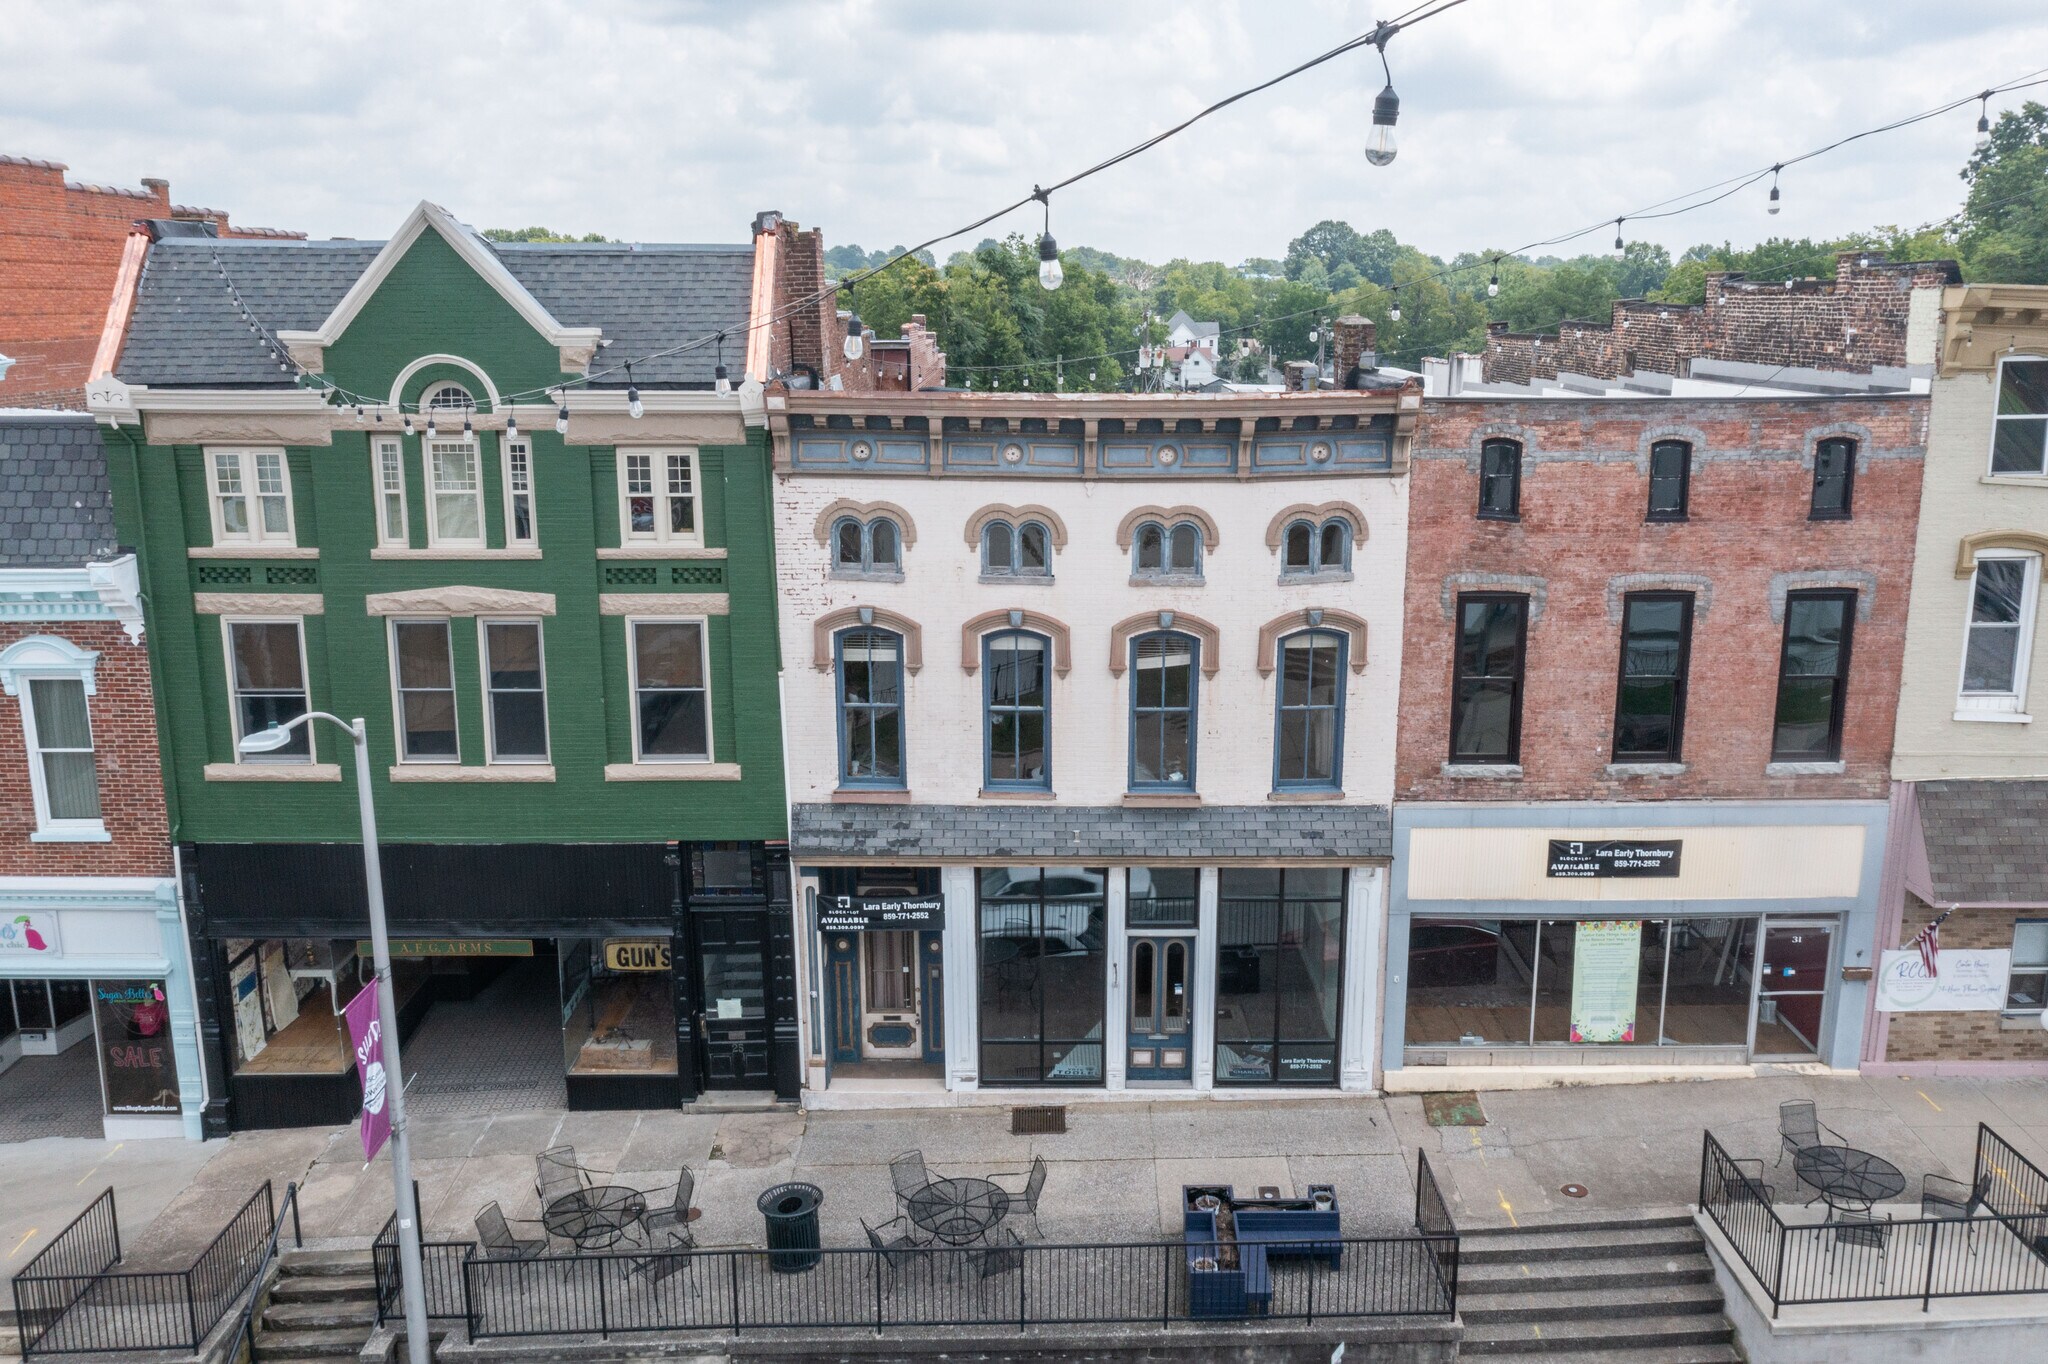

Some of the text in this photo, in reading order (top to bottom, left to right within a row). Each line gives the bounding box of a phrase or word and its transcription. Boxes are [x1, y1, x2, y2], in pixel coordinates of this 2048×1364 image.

[1595, 848, 1674, 859] Lara Early Thornbury
[863, 901, 941, 911] Lara Early Thornbury
[883, 912, 929, 920] 859-771-2552
[447, 943, 493, 953] ARMS
[732, 1043, 744, 1053] 25
[110, 1046, 162, 1068] SALE
